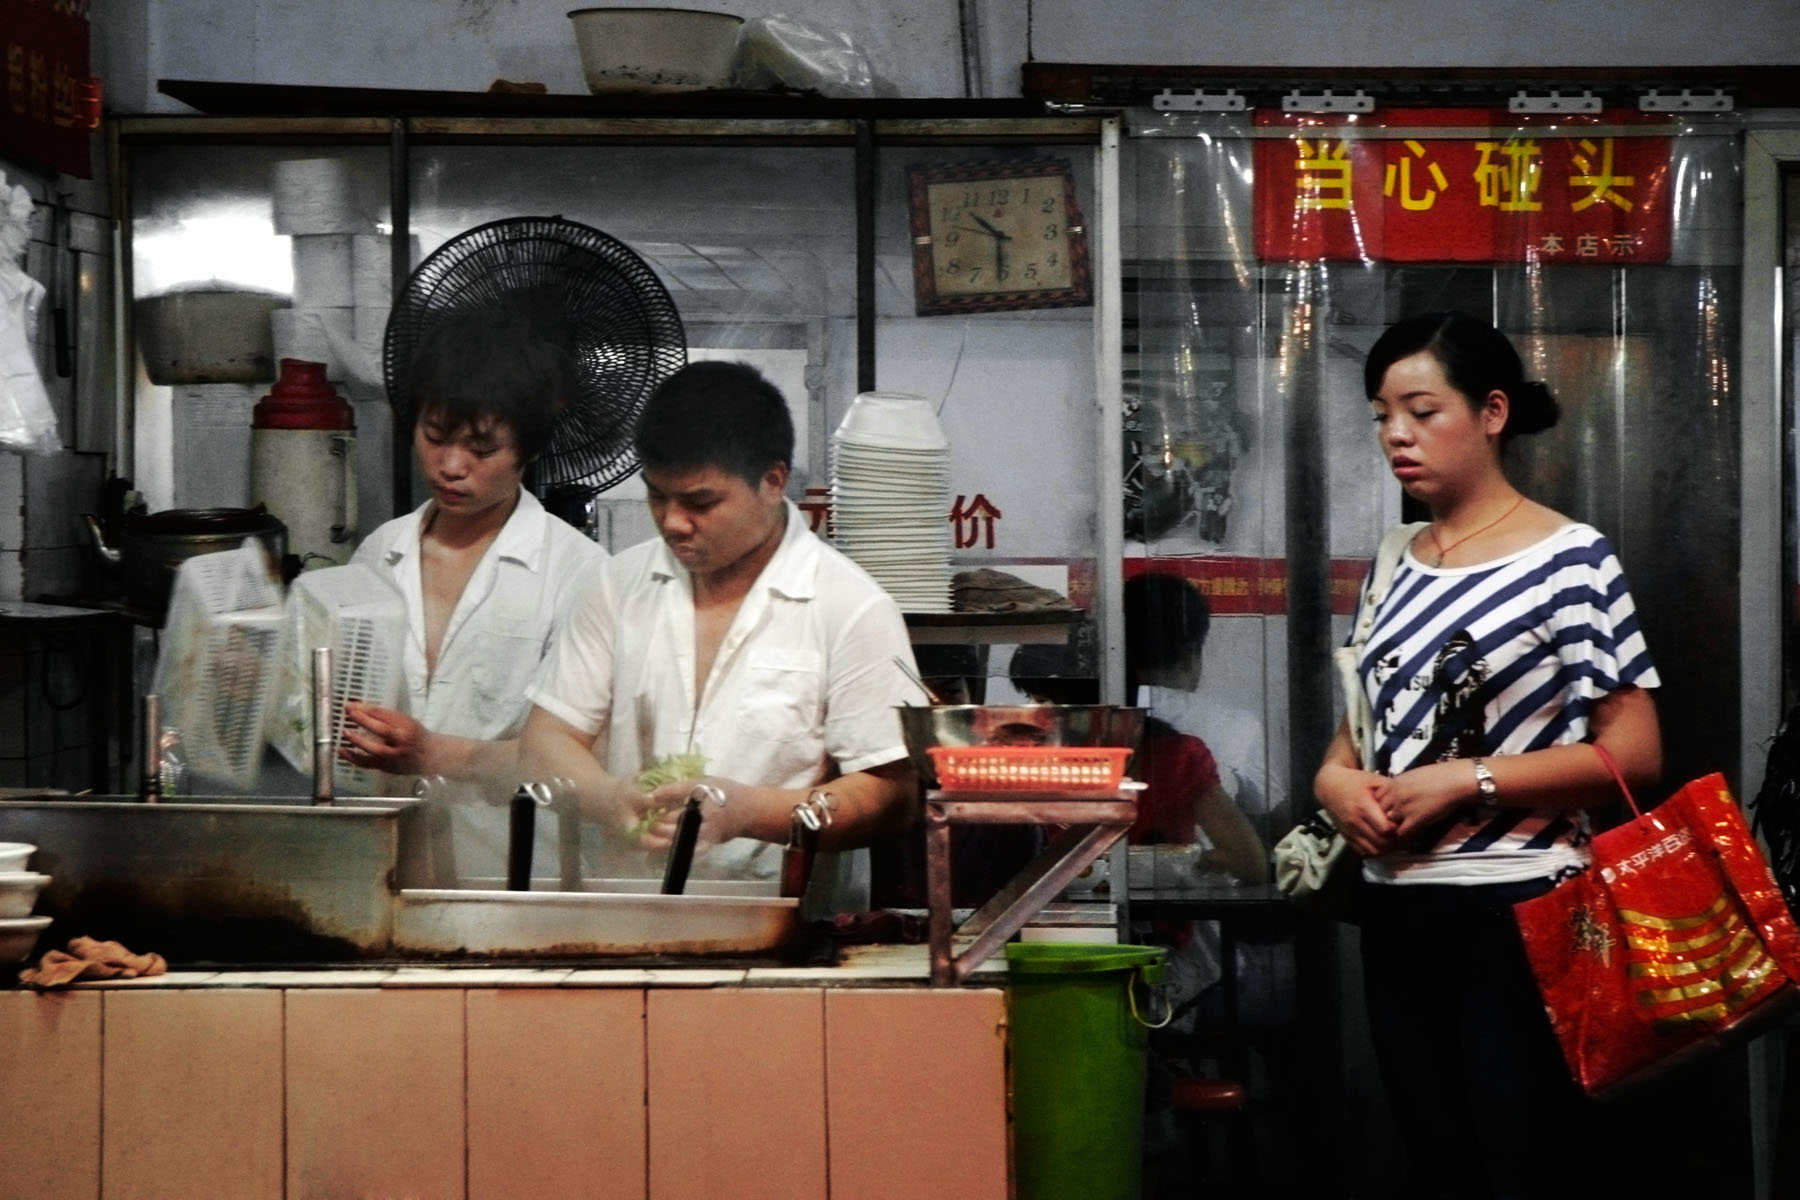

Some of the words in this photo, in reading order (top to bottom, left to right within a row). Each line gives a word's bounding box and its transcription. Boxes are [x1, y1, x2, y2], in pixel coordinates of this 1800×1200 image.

[1294, 138, 1635, 213] 当心碰头
[988, 189, 1009, 206] 12
[1041, 197, 1056, 214] 2
[944, 231, 960, 248] 9
[1043, 223, 1058, 240] 3
[1540, 234, 1636, 257] 本店示
[946, 259, 961, 275] 8
[1047, 252, 1059, 267] 4
[969, 266, 982, 283] 7
[1024, 263, 1038, 280] 5
[949, 494, 1001, 549] 价
